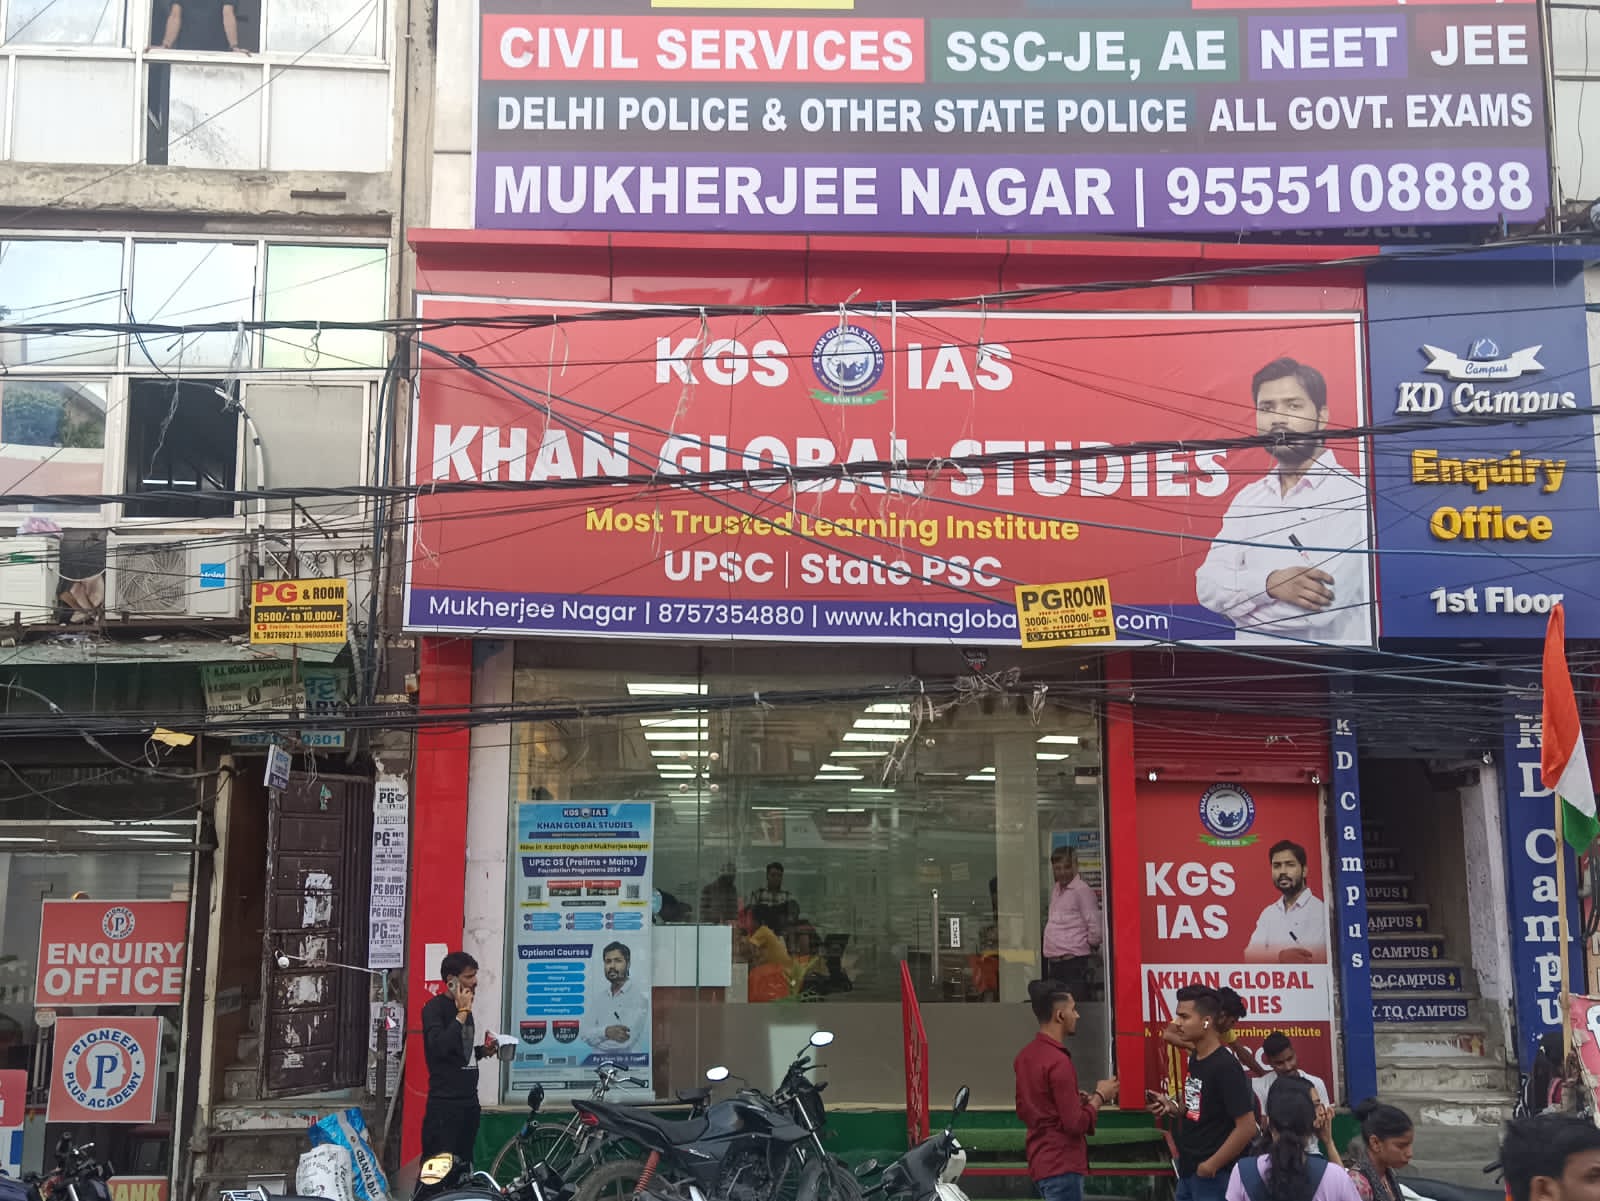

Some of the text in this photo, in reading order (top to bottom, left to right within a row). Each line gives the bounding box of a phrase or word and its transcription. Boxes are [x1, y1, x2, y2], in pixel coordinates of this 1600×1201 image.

[499, 27, 914, 72] CIVIL SERVICES
[945, 31, 1227, 81] SSC-JE, AE
[1260, 27, 1399, 70] NEET
[1430, 24, 1530, 67] JEE
[497, 96, 1188, 134] DELHI POLICE & OTHER STATE POLICE
[1208, 93, 1534, 132] ALL GOVT. EXAMS
[493, 165, 878, 216] MUKHERJEE
[900, 167, 1115, 217] NAGAR
[1165, 161, 1534, 216] 9555108888
[655, 336, 790, 387] KGS
[907, 343, 1014, 392] IAS
[1464, 361, 1508, 377] Campus
[1395, 382, 1577, 415] KD Campus
[431, 423, 1230, 498] KHAN GLOBAL STUDIES
[1411, 449, 1568, 493] Enquiry
[585, 507, 1080, 547] Most Trusted Learning Institute
[1430, 505, 1553, 541] Office
[664, 550, 775, 584] UPSC
[800, 553, 911, 586] State
[922, 555, 1002, 588] PSC
[255, 583, 345, 603] PG & ROOM
[1021, 585, 1107, 612] PG ROOM
[1430, 586, 1564, 614] 1st Floor
[429, 595, 556, 622] Mukherjee
[561, 601, 637, 626] Nagar
[658, 603, 804, 625] 8757354880
[536, 821, 634, 830] KHAN GLOBAL STUDIES
[592, 807, 608, 816] IAS
[374, 831, 391, 847] PG
[384, 883, 404, 895] BOYS
[1145, 861, 1237, 898] KGS
[112, 917, 125, 932] P
[1156, 904, 1230, 940] IAS
[1368, 916, 1414, 929] AMPUS
[47, 942, 185, 966] ENQUIRY
[521, 947, 590, 957] Optional Courses
[1371, 946, 1430, 958] CAMPUS
[43, 966, 183, 997] OFFICE
[1157, 971, 1315, 990] KHAN GLOBAL
[1387, 974, 1447, 987] CAMPUS
[1407, 1005, 1467, 1018] CAMPUS
[72, 1029, 140, 1056] PIONEER
[92, 1055, 119, 1090] P
[64, 1071, 142, 1109] PLUS ACADEMY
[109, 1183, 161, 1201] ANK
